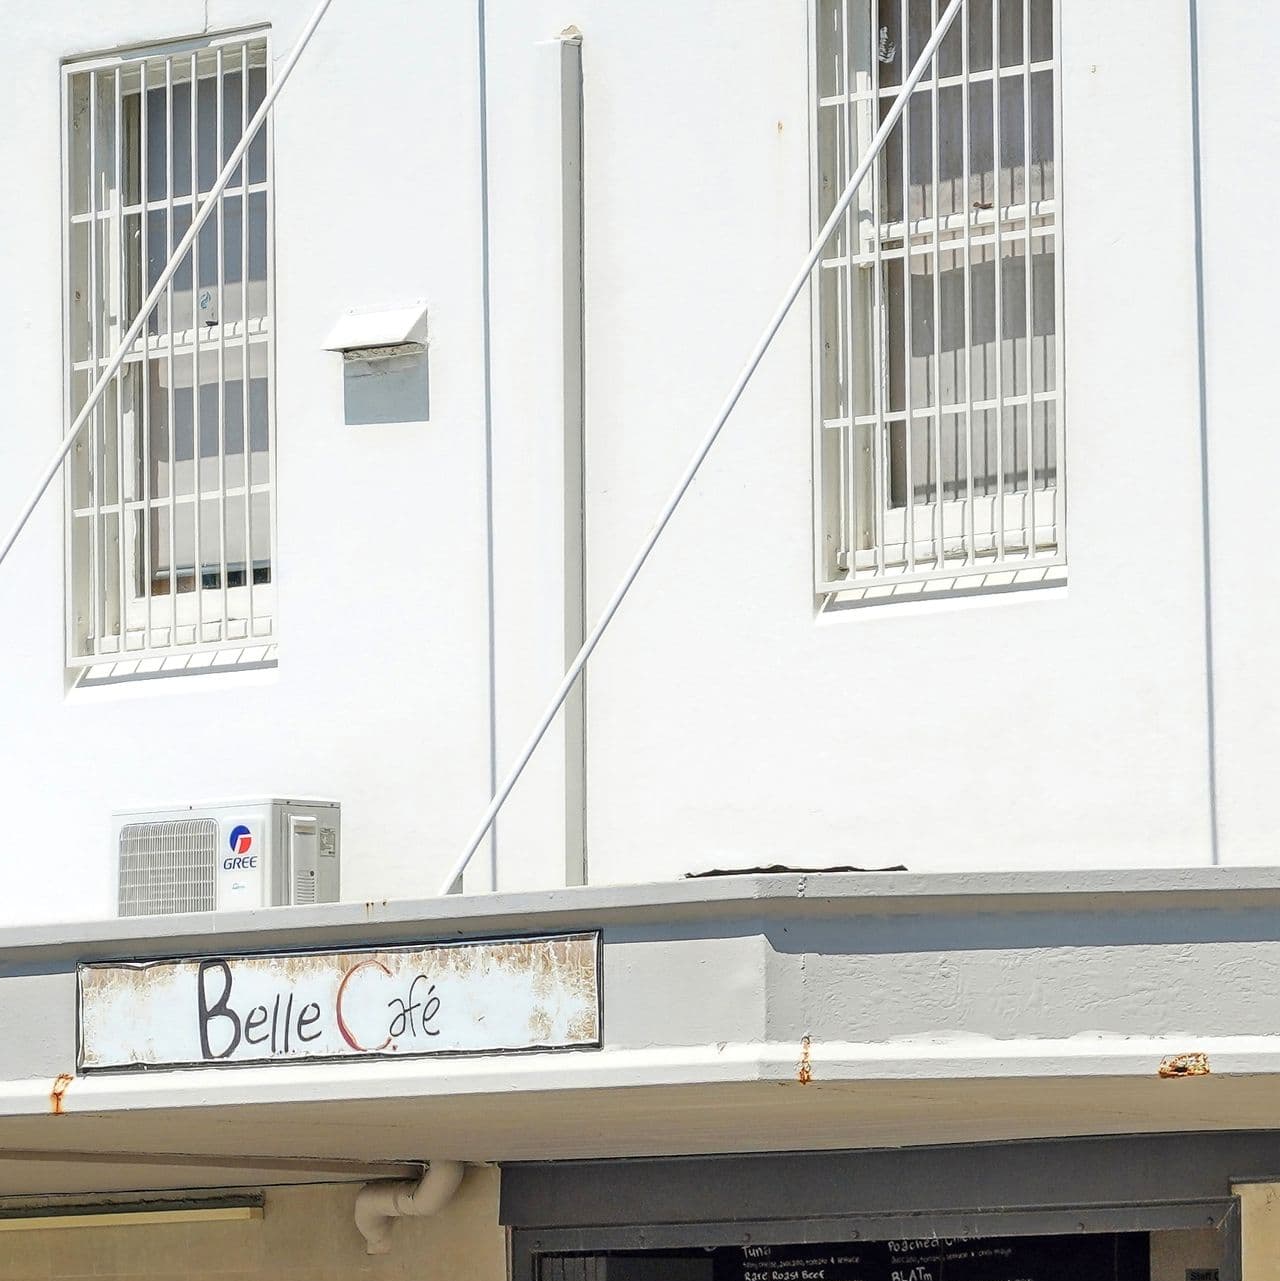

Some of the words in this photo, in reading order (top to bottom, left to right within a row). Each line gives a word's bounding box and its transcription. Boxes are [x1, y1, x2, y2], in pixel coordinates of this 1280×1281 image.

[223, 855, 258, 870] GREE
[198, 957, 322, 1059] Belle
[336, 958, 441, 1052] Café
[741, 1245, 771, 1258] Tuna
[744, 1271, 768, 1281] Rare
[772, 1270, 799, 1280] Roast
[802, 1269, 825, 1280] Beef
